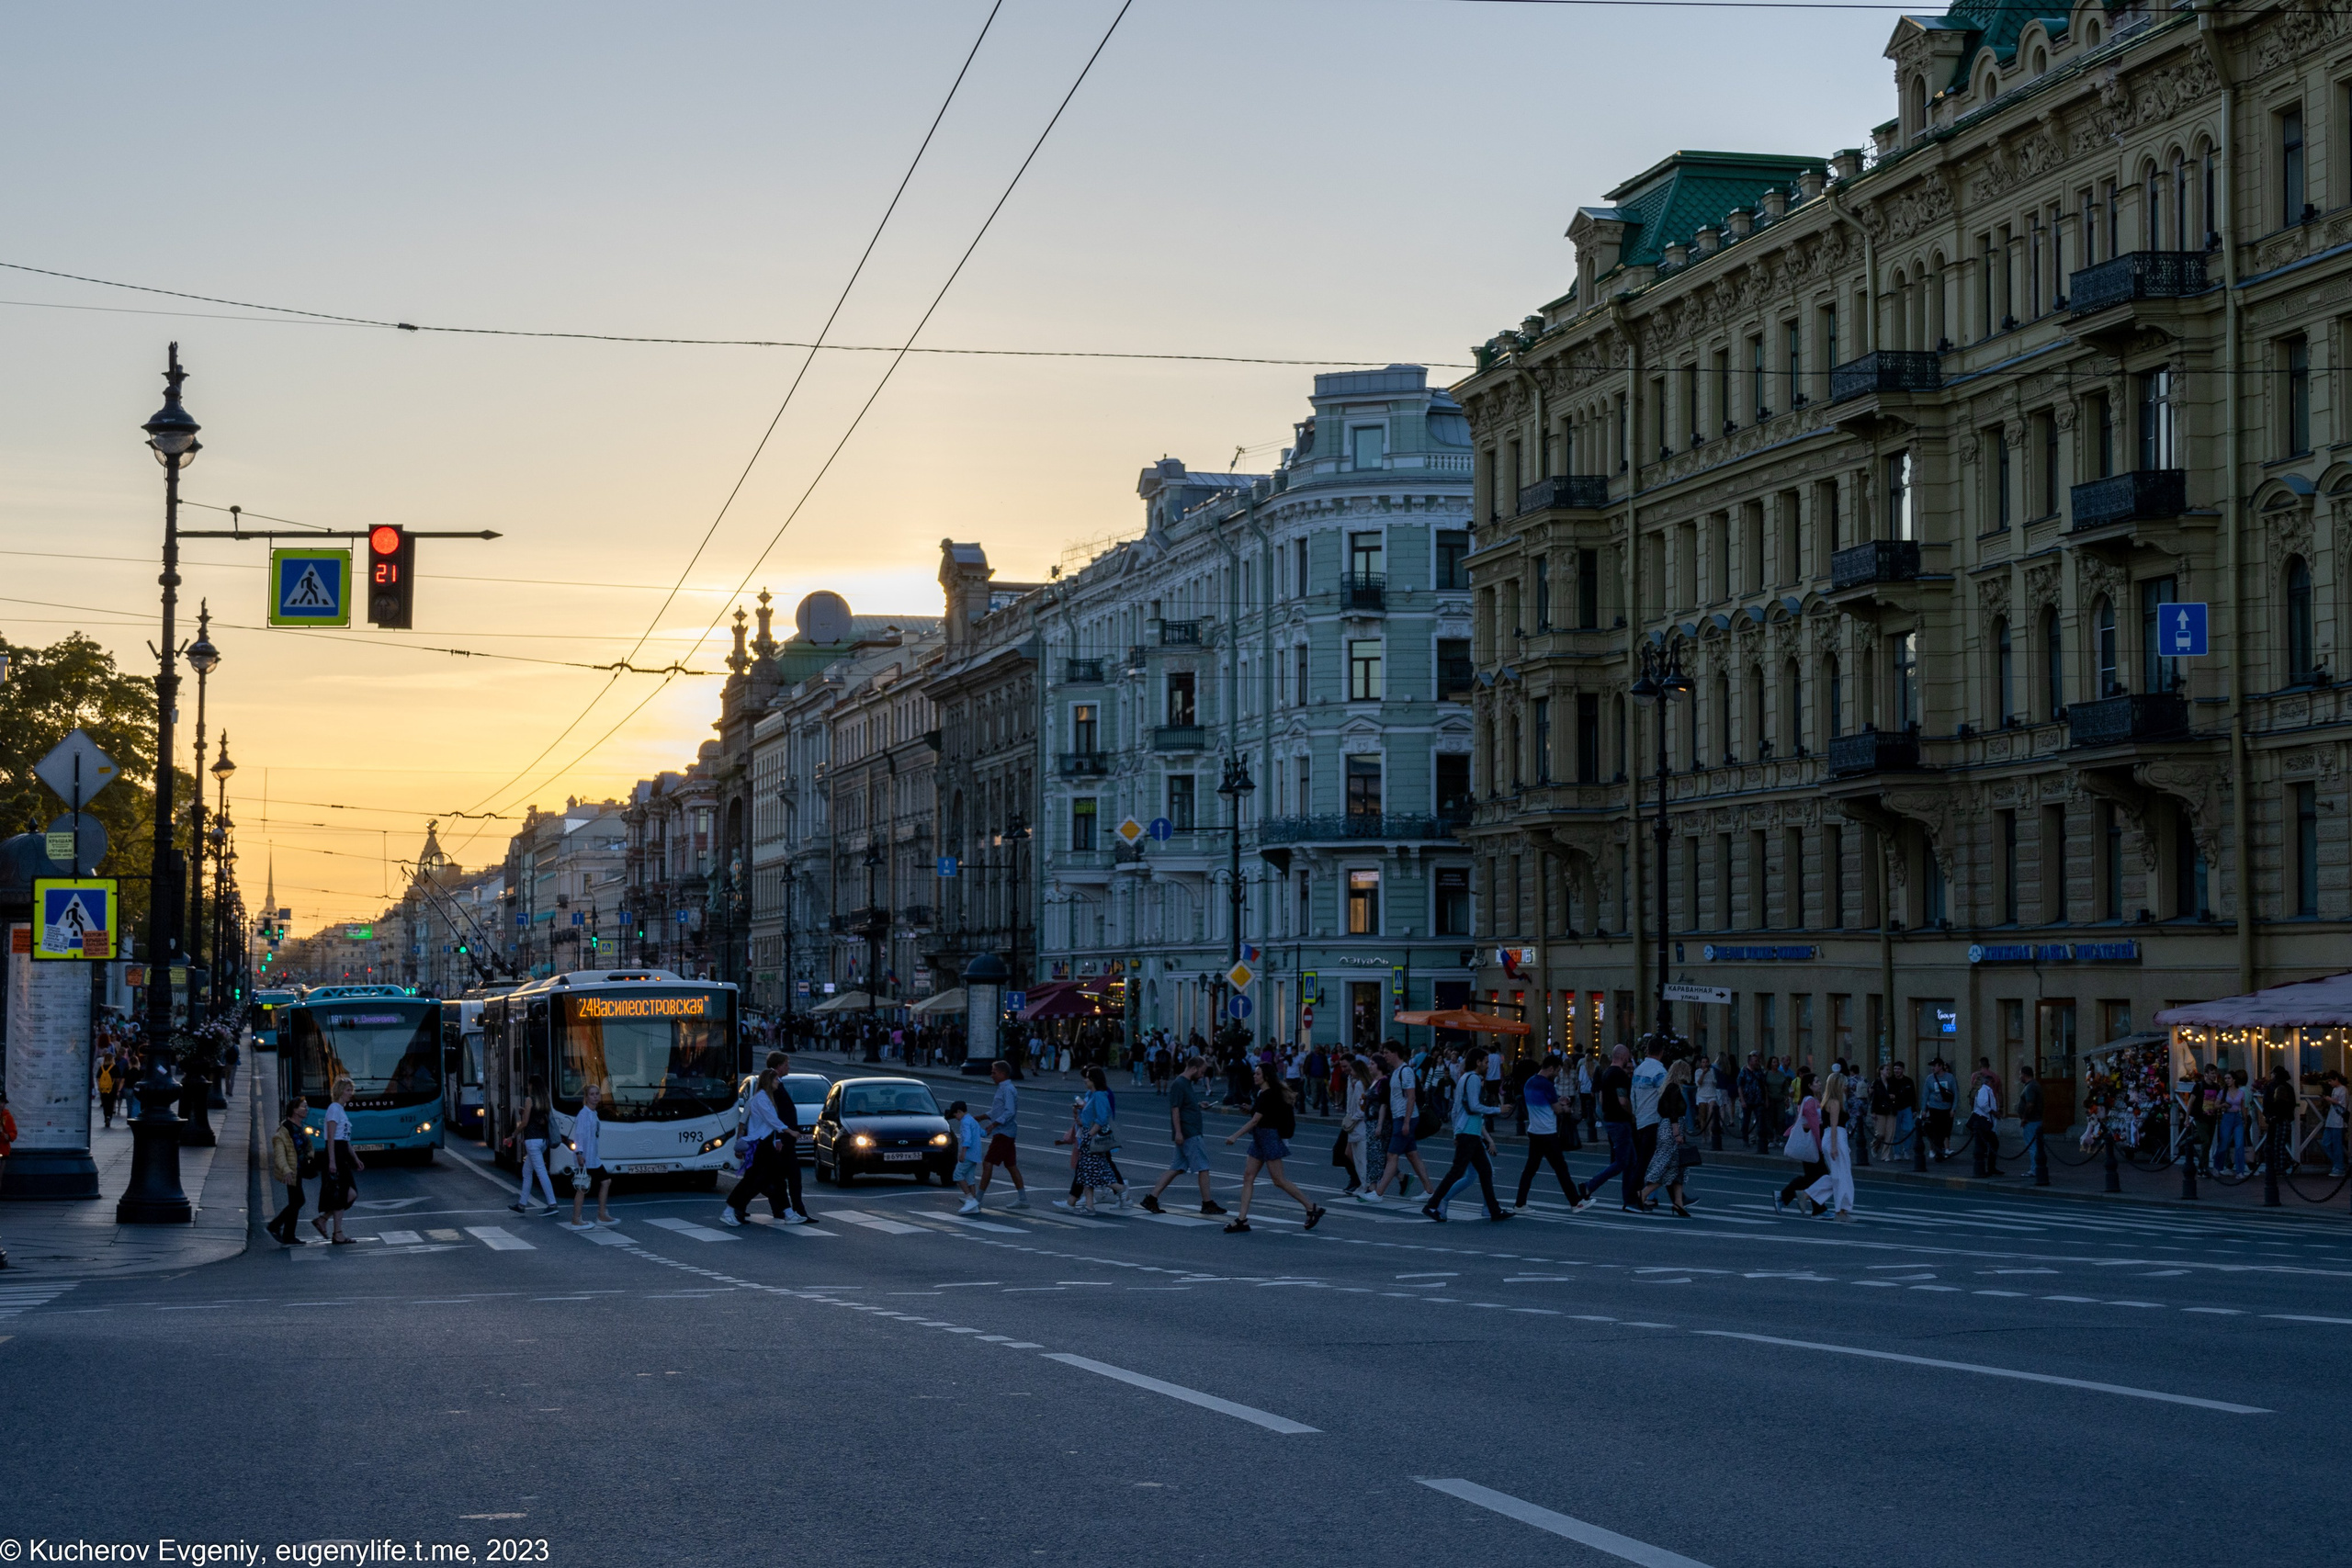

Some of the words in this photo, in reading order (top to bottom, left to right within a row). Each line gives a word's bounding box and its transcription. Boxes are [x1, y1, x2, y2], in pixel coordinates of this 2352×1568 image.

[375, 563, 397, 583] 21
[1984, 945, 2033, 961] КНИЖНАЯ
[2037, 944, 2073, 960] ЛАВКА
[2075, 939, 2137, 959] ПИСАТЕЛЕЙ
[1668, 985, 1713, 994] КАРАВАННАЯ
[330, 1015, 343, 1023] 191
[678, 1131, 704, 1144] 1993
